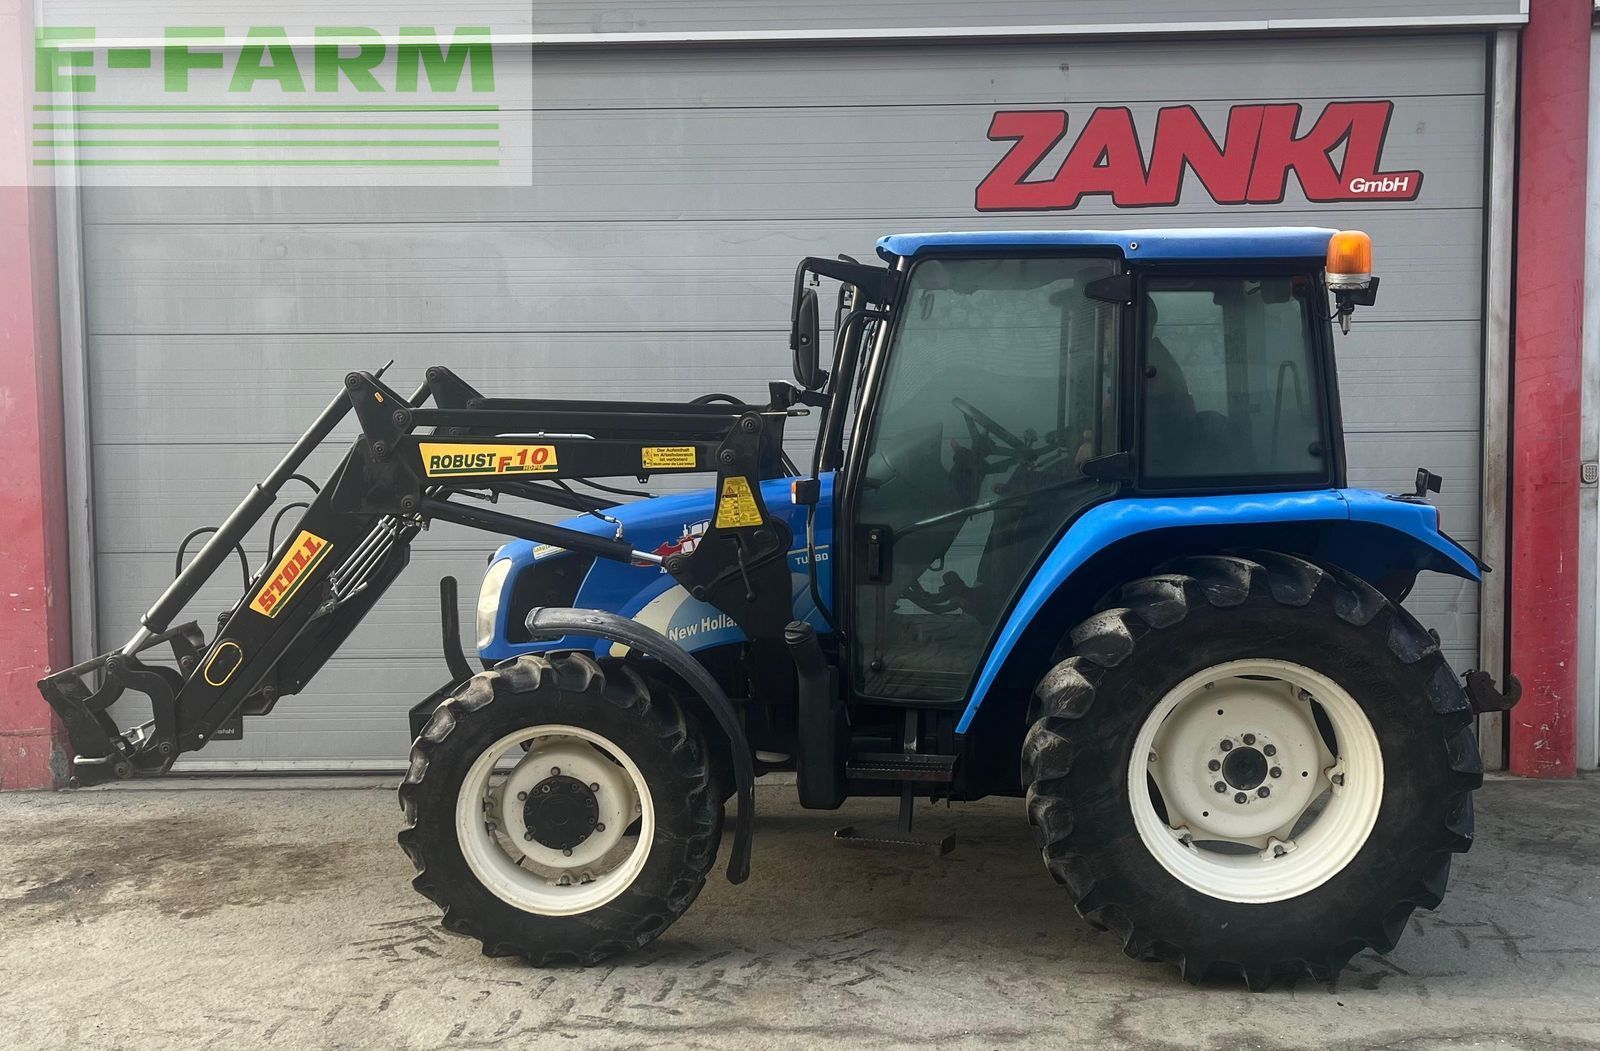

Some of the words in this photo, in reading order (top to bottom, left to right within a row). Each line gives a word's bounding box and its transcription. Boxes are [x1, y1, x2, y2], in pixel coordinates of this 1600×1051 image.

[975, 101, 1423, 211] ZANKL
[1349, 176, 1408, 193] GmbH
[429, 453, 496, 469] ROBUST
[795, 553, 828, 565] TUBO
[258, 537, 322, 612] STOLL
[669, 624, 698, 641] New
[701, 614, 737, 632] Holla
